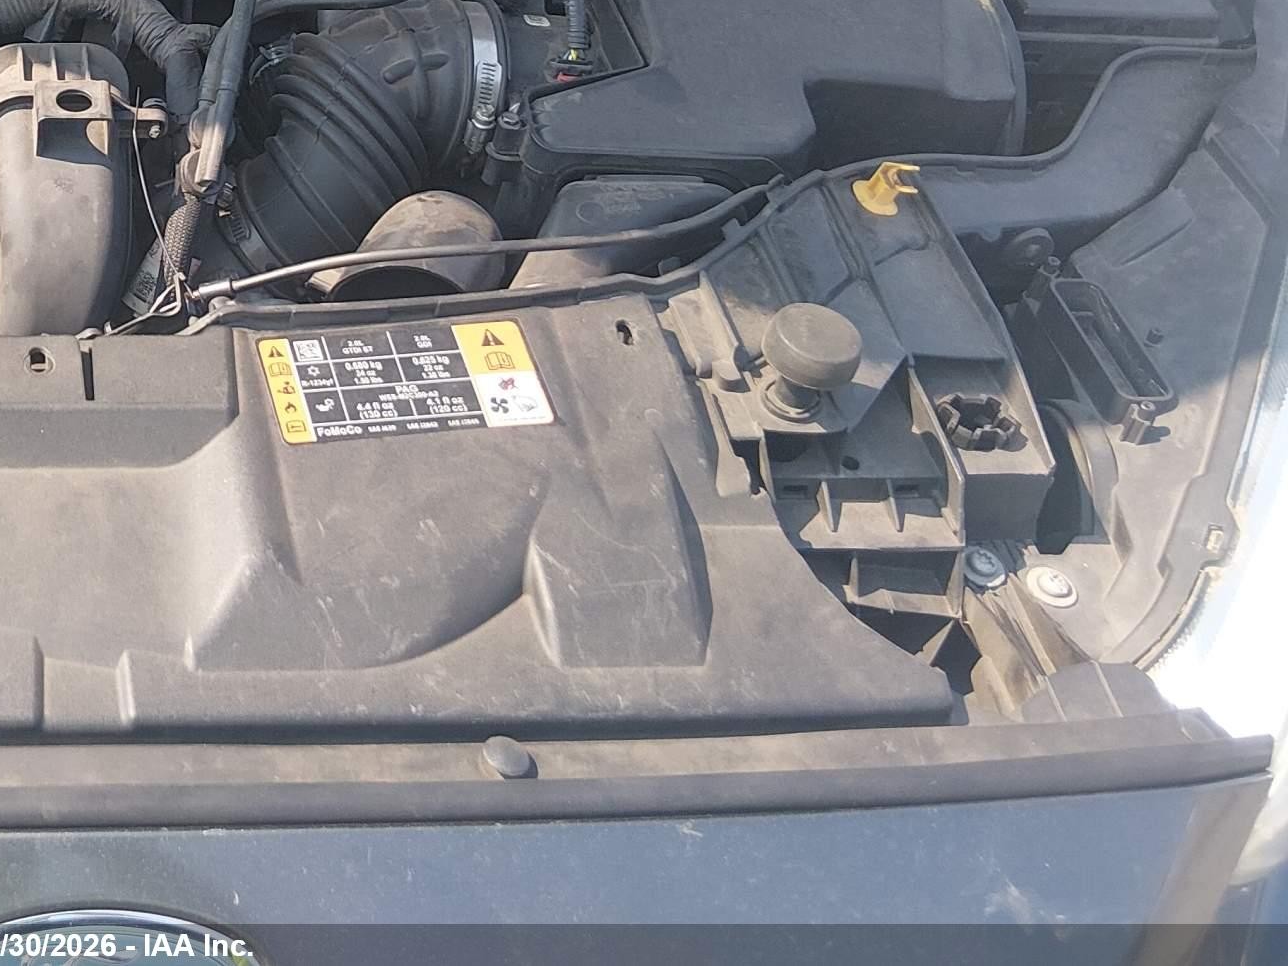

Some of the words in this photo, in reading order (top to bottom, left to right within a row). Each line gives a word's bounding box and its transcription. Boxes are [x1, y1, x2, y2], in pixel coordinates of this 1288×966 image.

[436, 355, 450, 365] kg
[369, 361, 383, 370] kg
[394, 385, 419, 394] PAG
[429, 405, 451, 415] (120
[451, 403, 468, 412] cc)
[360, 410, 381, 420] (130
[381, 409, 398, 417] cc)
[316, 425, 362, 437] FoMoCo
